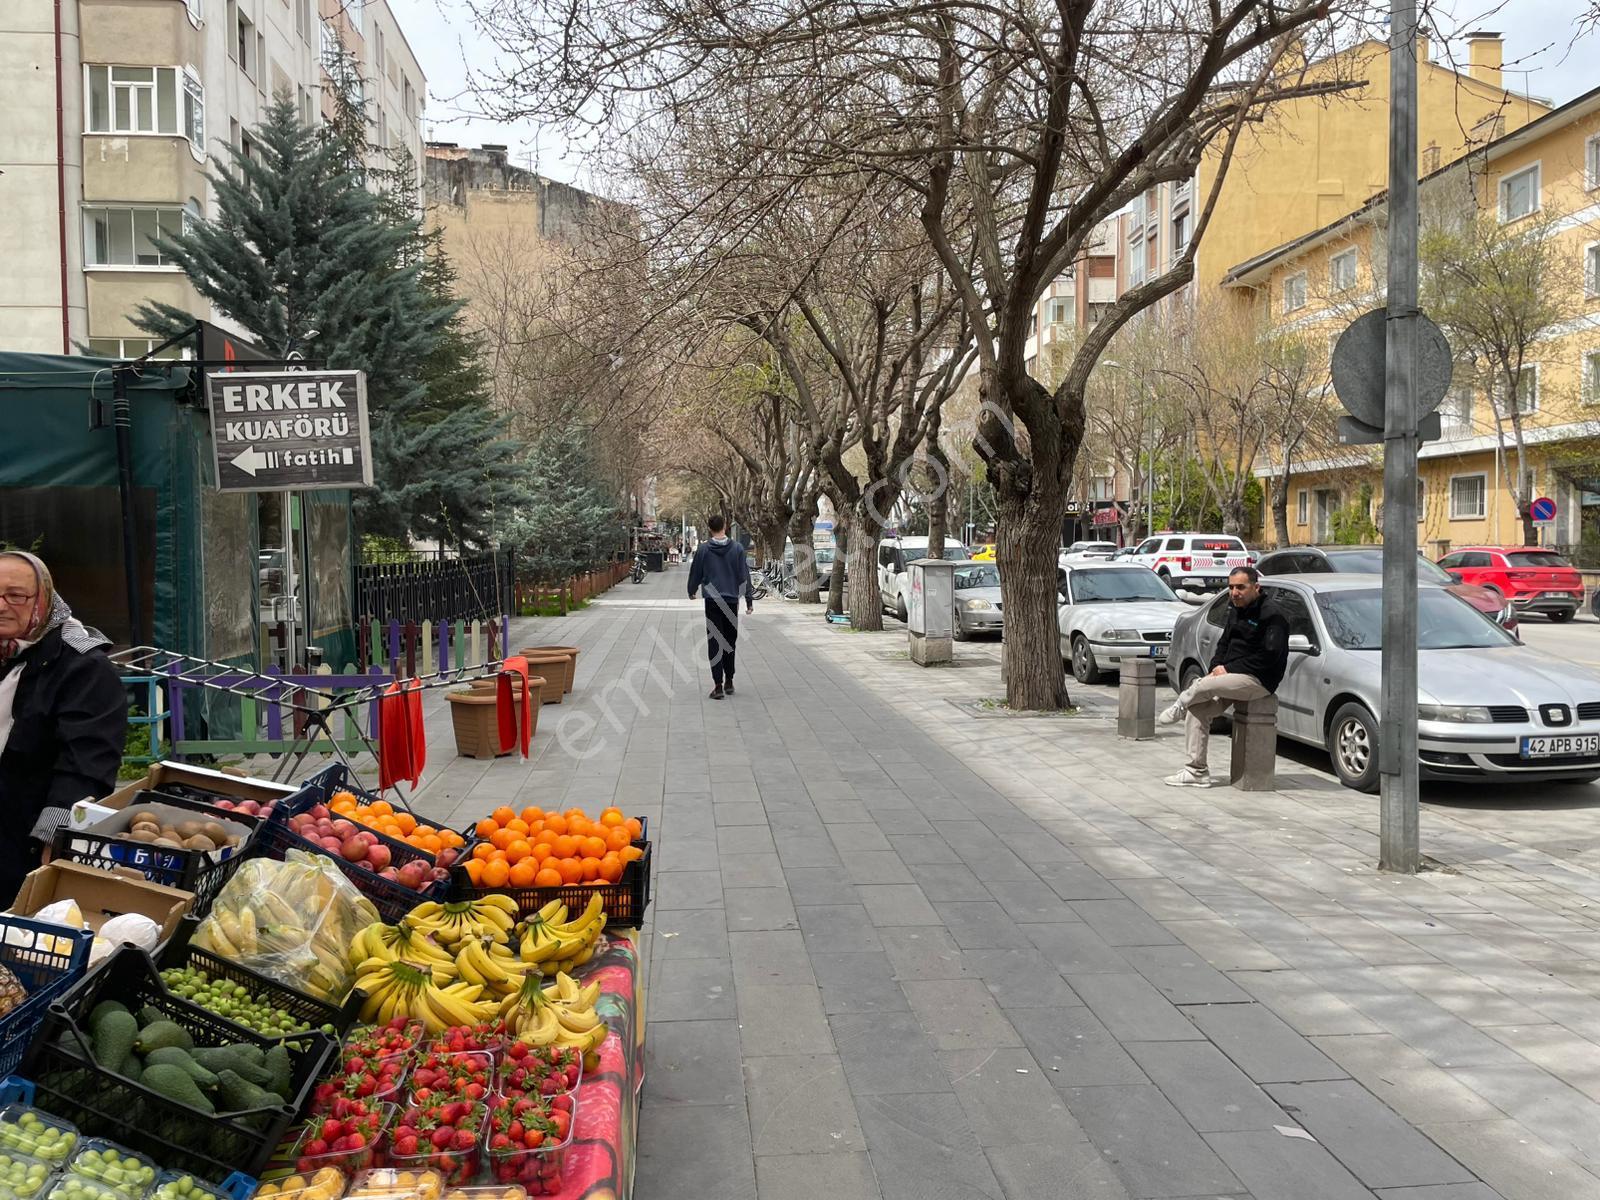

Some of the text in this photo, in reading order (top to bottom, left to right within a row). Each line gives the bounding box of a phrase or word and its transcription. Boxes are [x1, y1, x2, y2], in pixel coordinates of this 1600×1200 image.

[222, 381, 346, 413] ERKEK
[225, 412, 349, 442] KUAFÖRÜ
[283, 448, 341, 467] fatih
[1529, 737, 1597, 753] 42 APB 915
